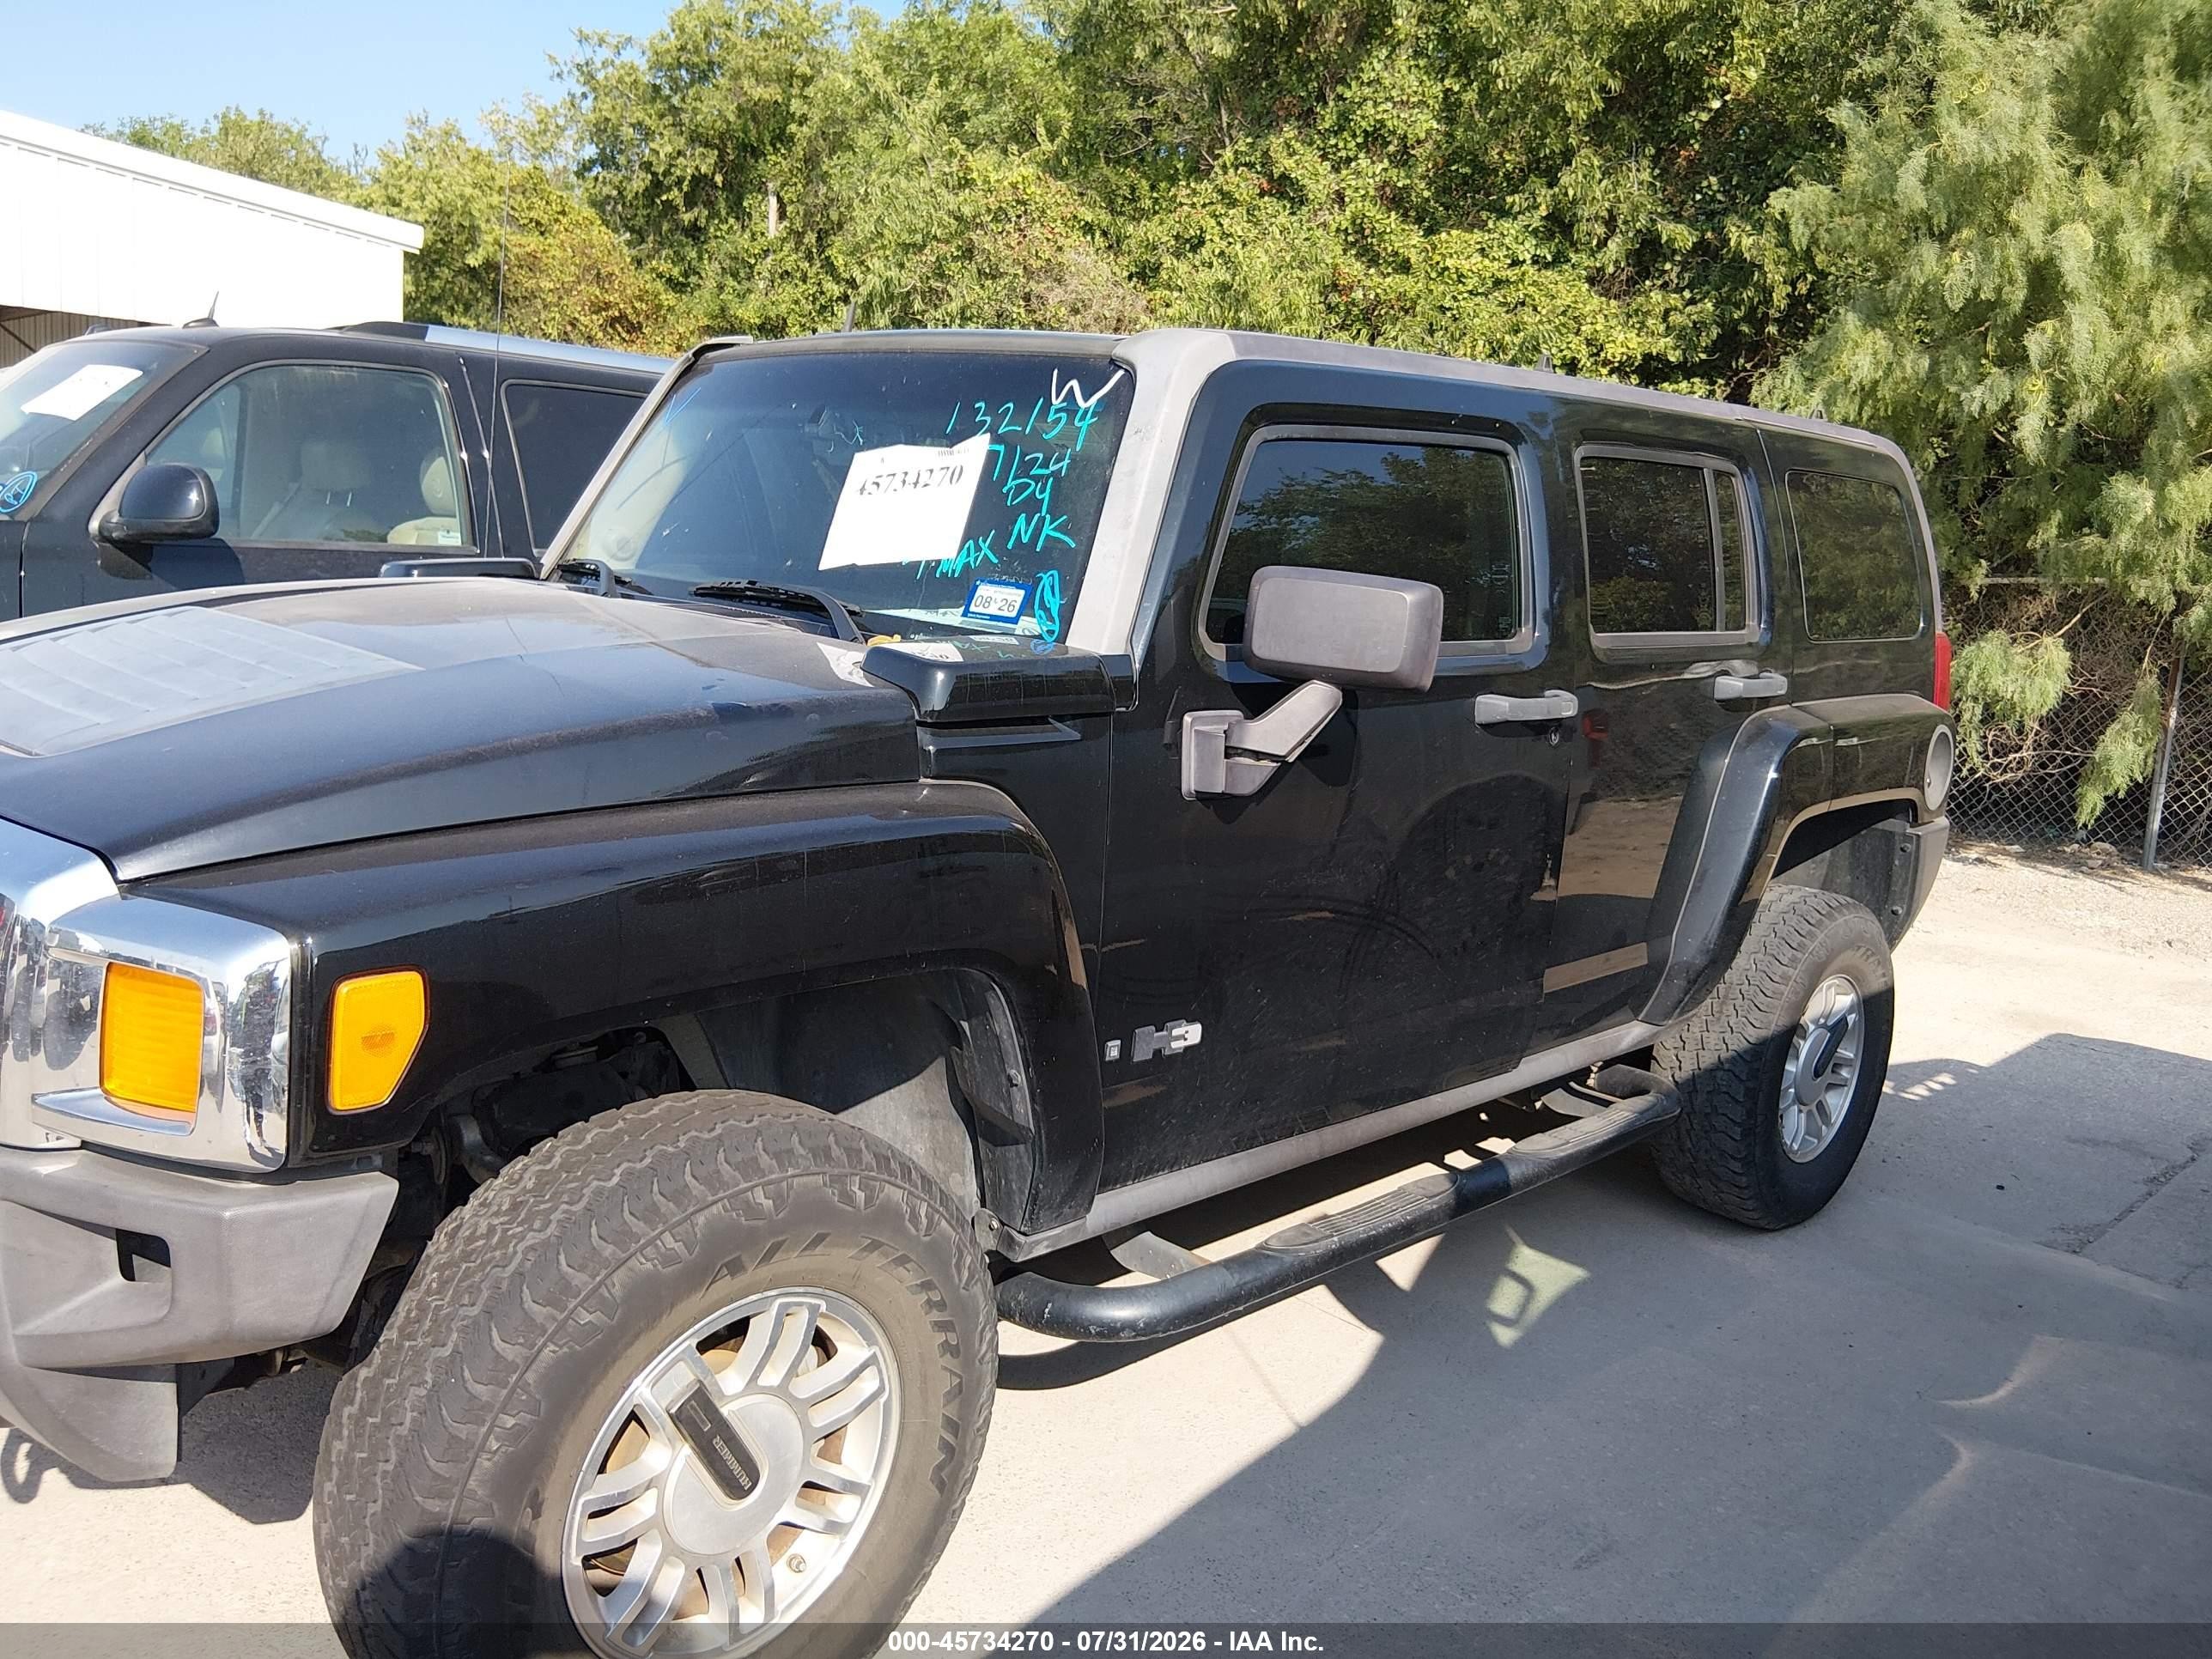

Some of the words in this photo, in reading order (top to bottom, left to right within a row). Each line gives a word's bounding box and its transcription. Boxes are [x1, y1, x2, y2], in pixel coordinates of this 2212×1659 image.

[857, 465, 963, 495] 45734270
[974, 594, 993, 611] 08
[997, 598, 1018, 613] 26
[1131, 1018, 1202, 1062] H3
[712, 1434, 752, 1491] HUMMER
